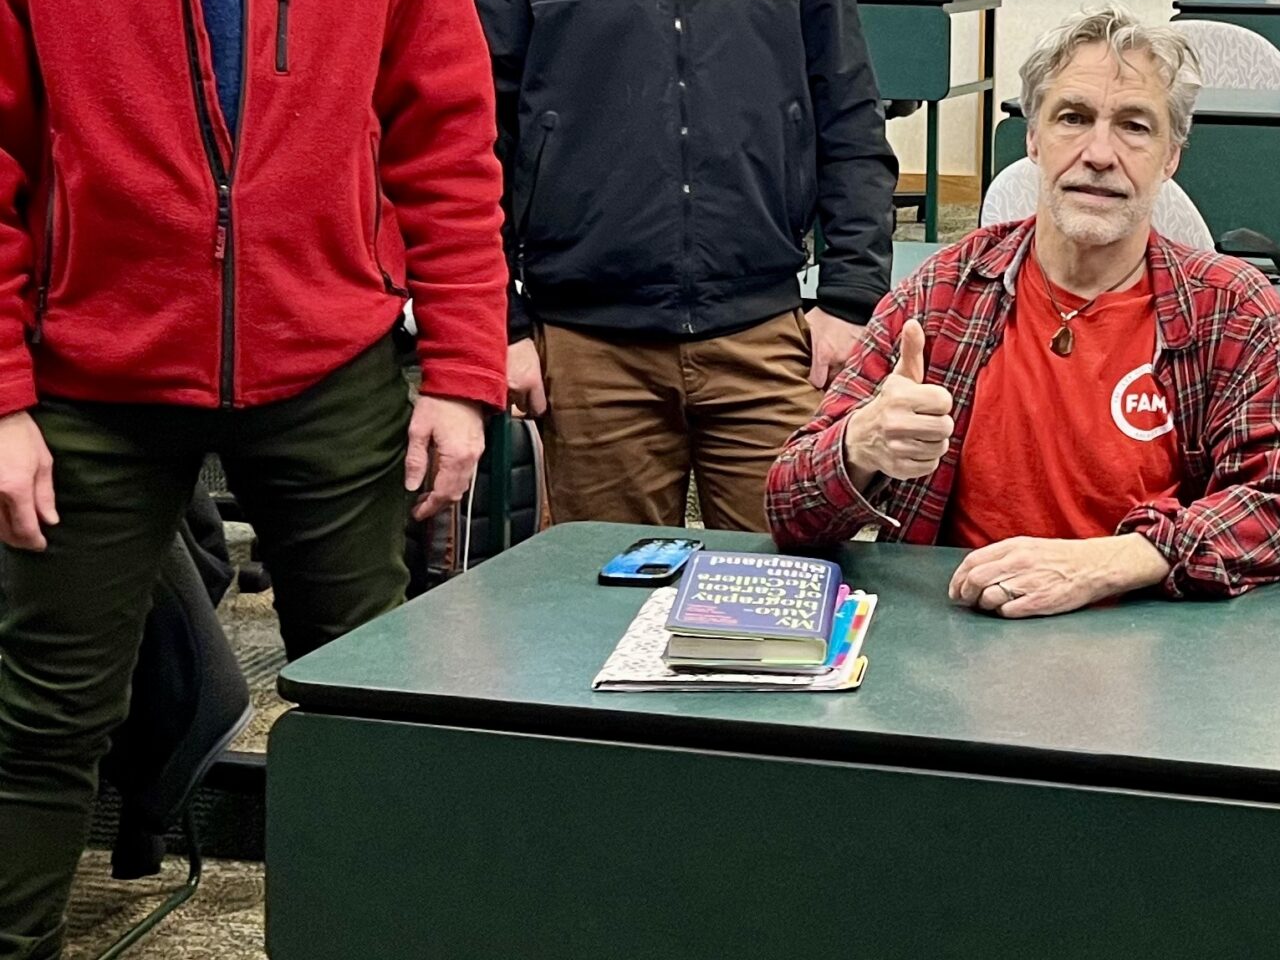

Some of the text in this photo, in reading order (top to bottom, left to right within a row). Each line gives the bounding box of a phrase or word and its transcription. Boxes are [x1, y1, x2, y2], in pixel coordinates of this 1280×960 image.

[1125, 392, 1168, 414] FAM
[698, 583, 822, 599] of Carson
[691, 591, 819, 611] biography
[775, 617, 815, 630] My
